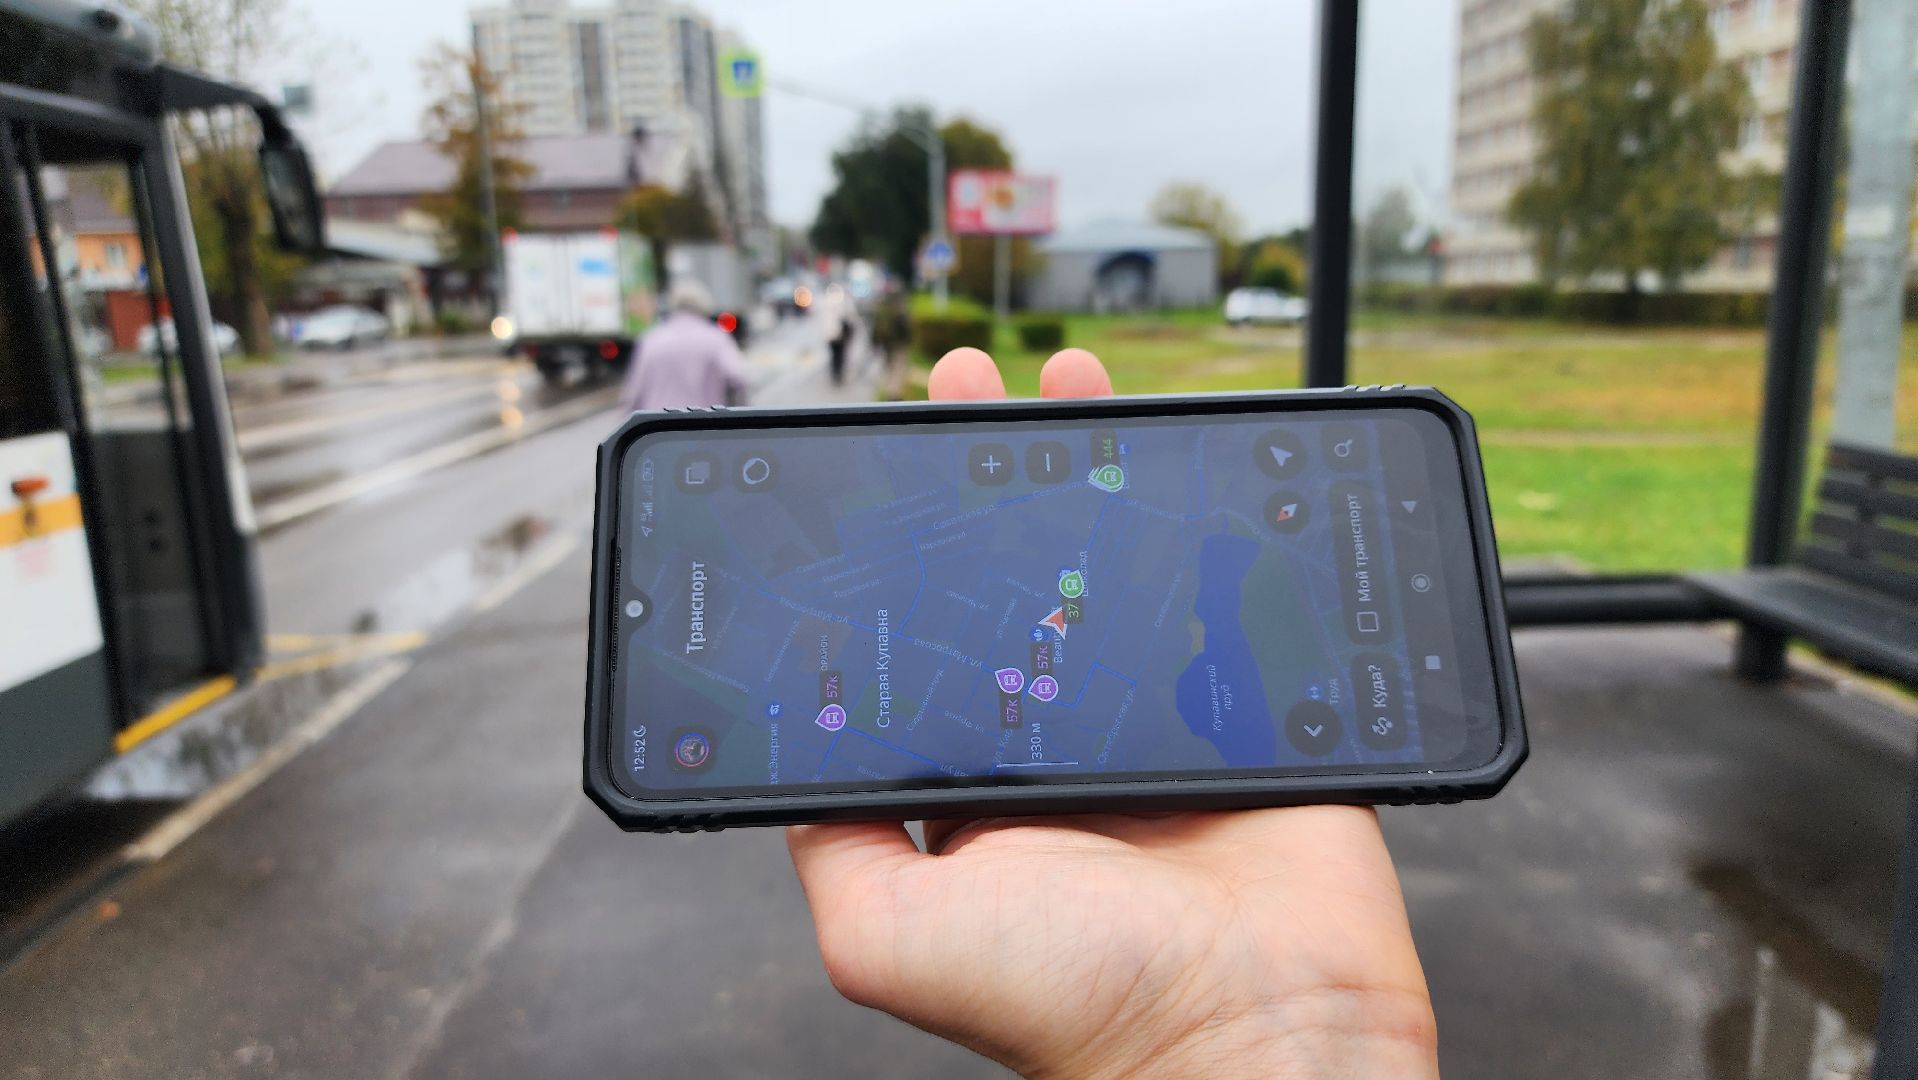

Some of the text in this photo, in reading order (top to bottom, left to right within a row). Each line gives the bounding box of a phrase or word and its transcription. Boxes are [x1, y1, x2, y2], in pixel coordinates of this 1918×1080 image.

[1344, 492, 1373, 603] Мой транспорт
[686, 560, 708, 655] Транспорт
[1068, 603, 1080, 619] 37
[876, 608, 893, 729] Старая Купавна
[1367, 664, 1389, 708] Куда?
[1205, 664, 1225, 732] Купавинский
[1220, 683, 1234, 711] пруд
[1328, 678, 1341, 705] Труд
[633, 738, 646, 772] 12:52
[768, 722, 780, 769] Энергия
[1031, 736, 1043, 761] 330
